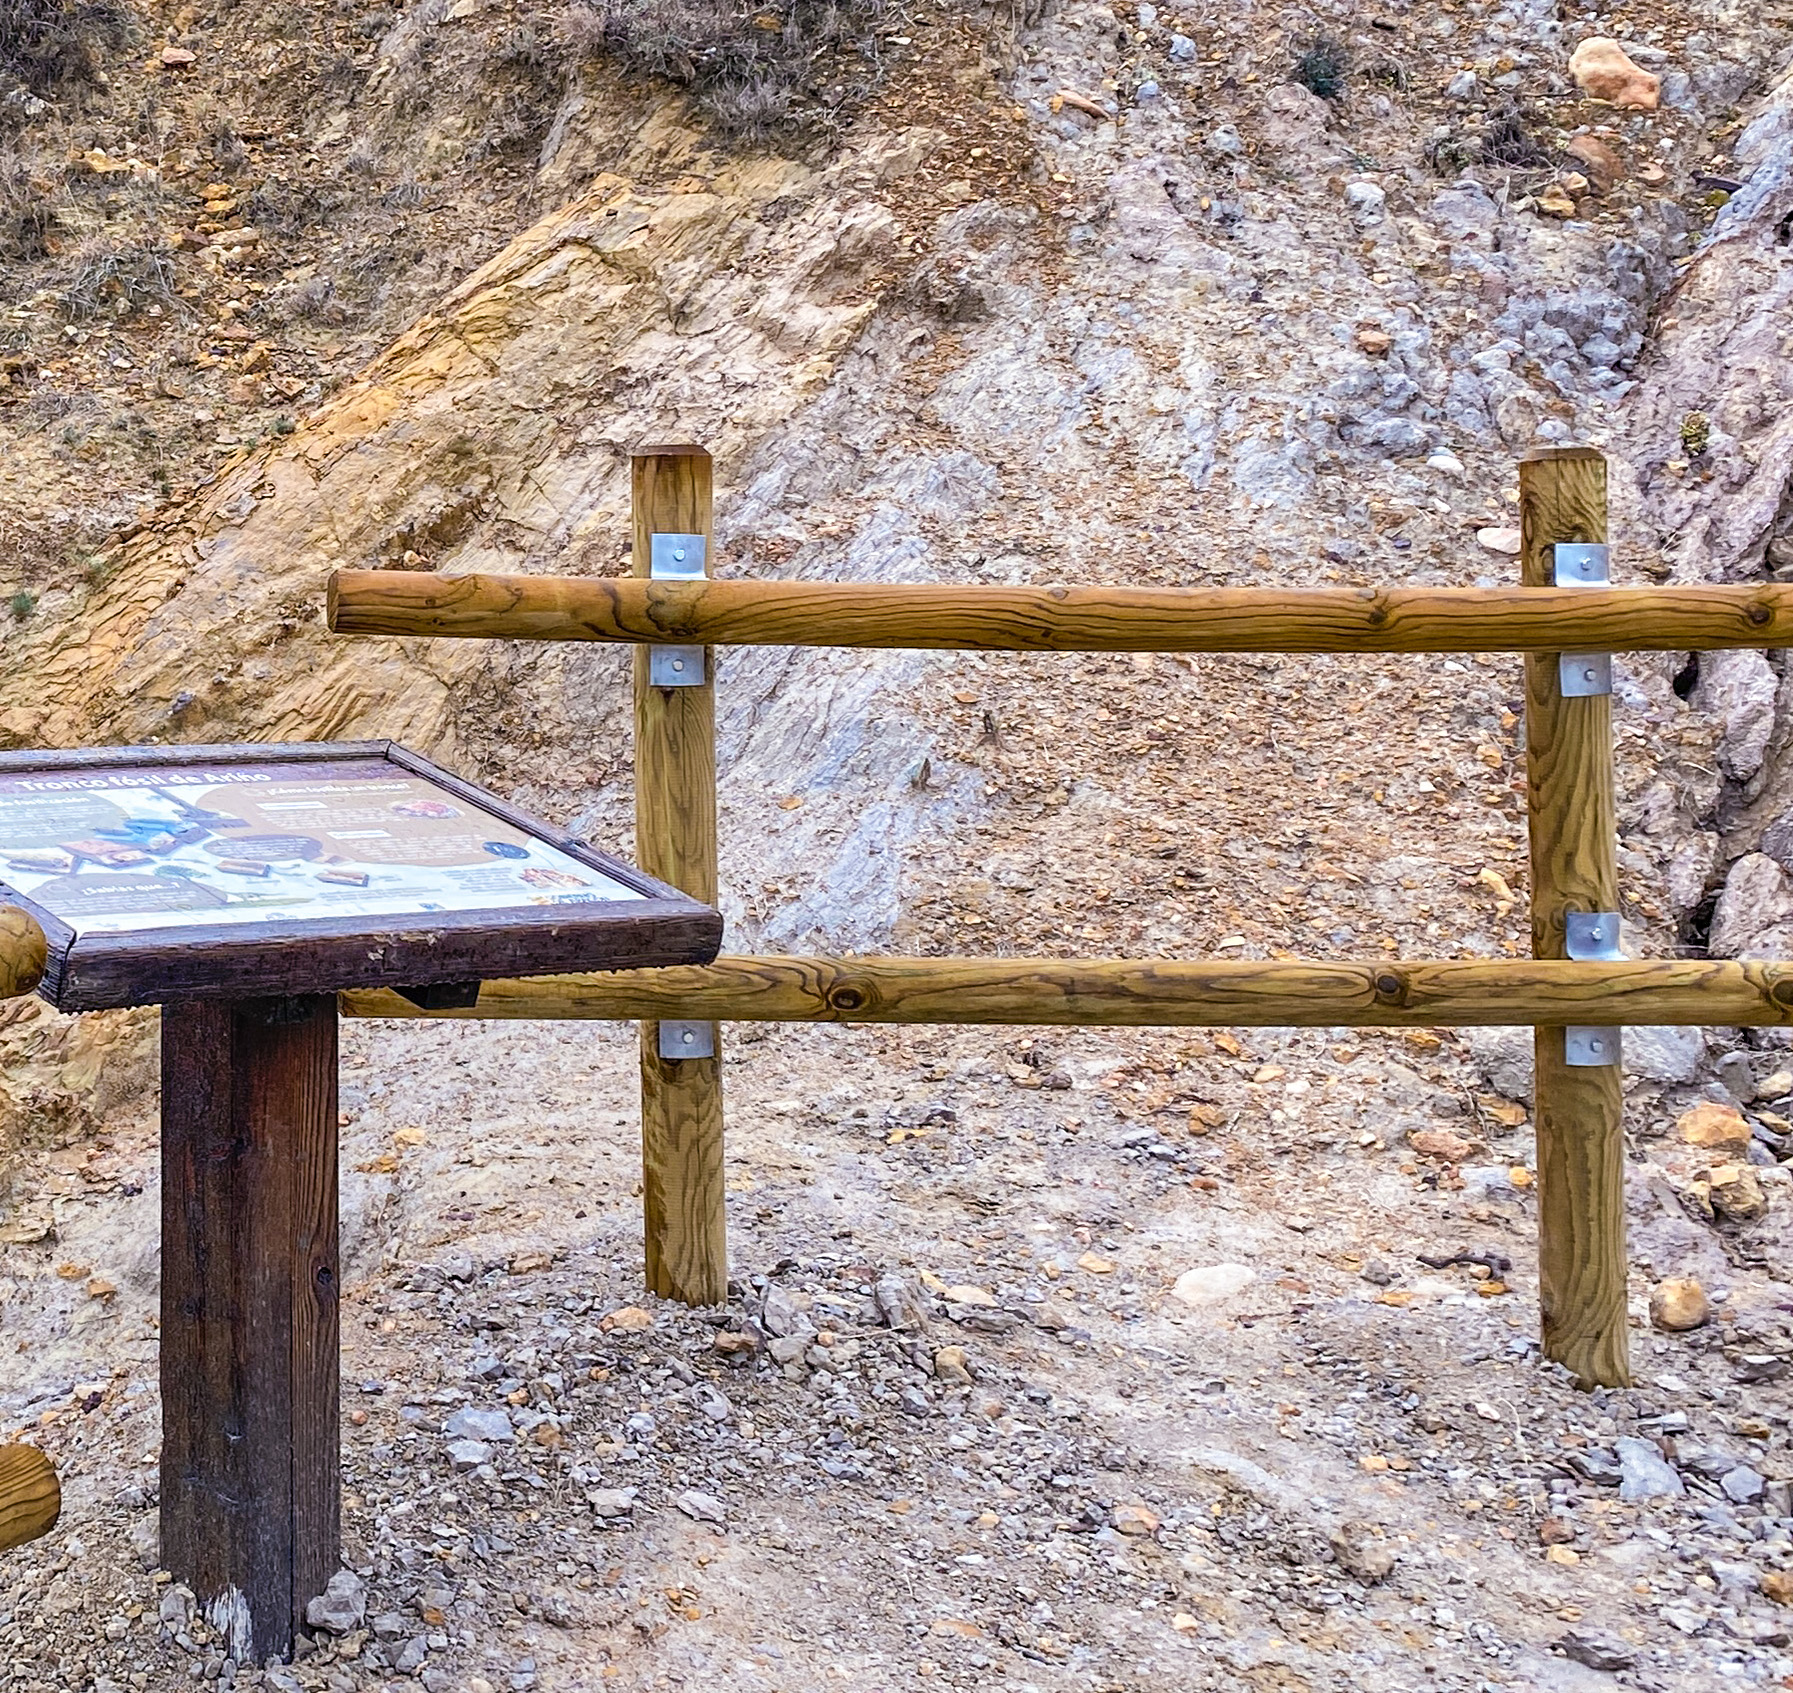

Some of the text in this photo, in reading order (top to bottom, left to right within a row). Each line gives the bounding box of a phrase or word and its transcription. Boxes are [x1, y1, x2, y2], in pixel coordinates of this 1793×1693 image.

[15, 778, 109, 792] Tronco
[109, 774, 168, 788] fósil
[169, 774, 202, 785] de
